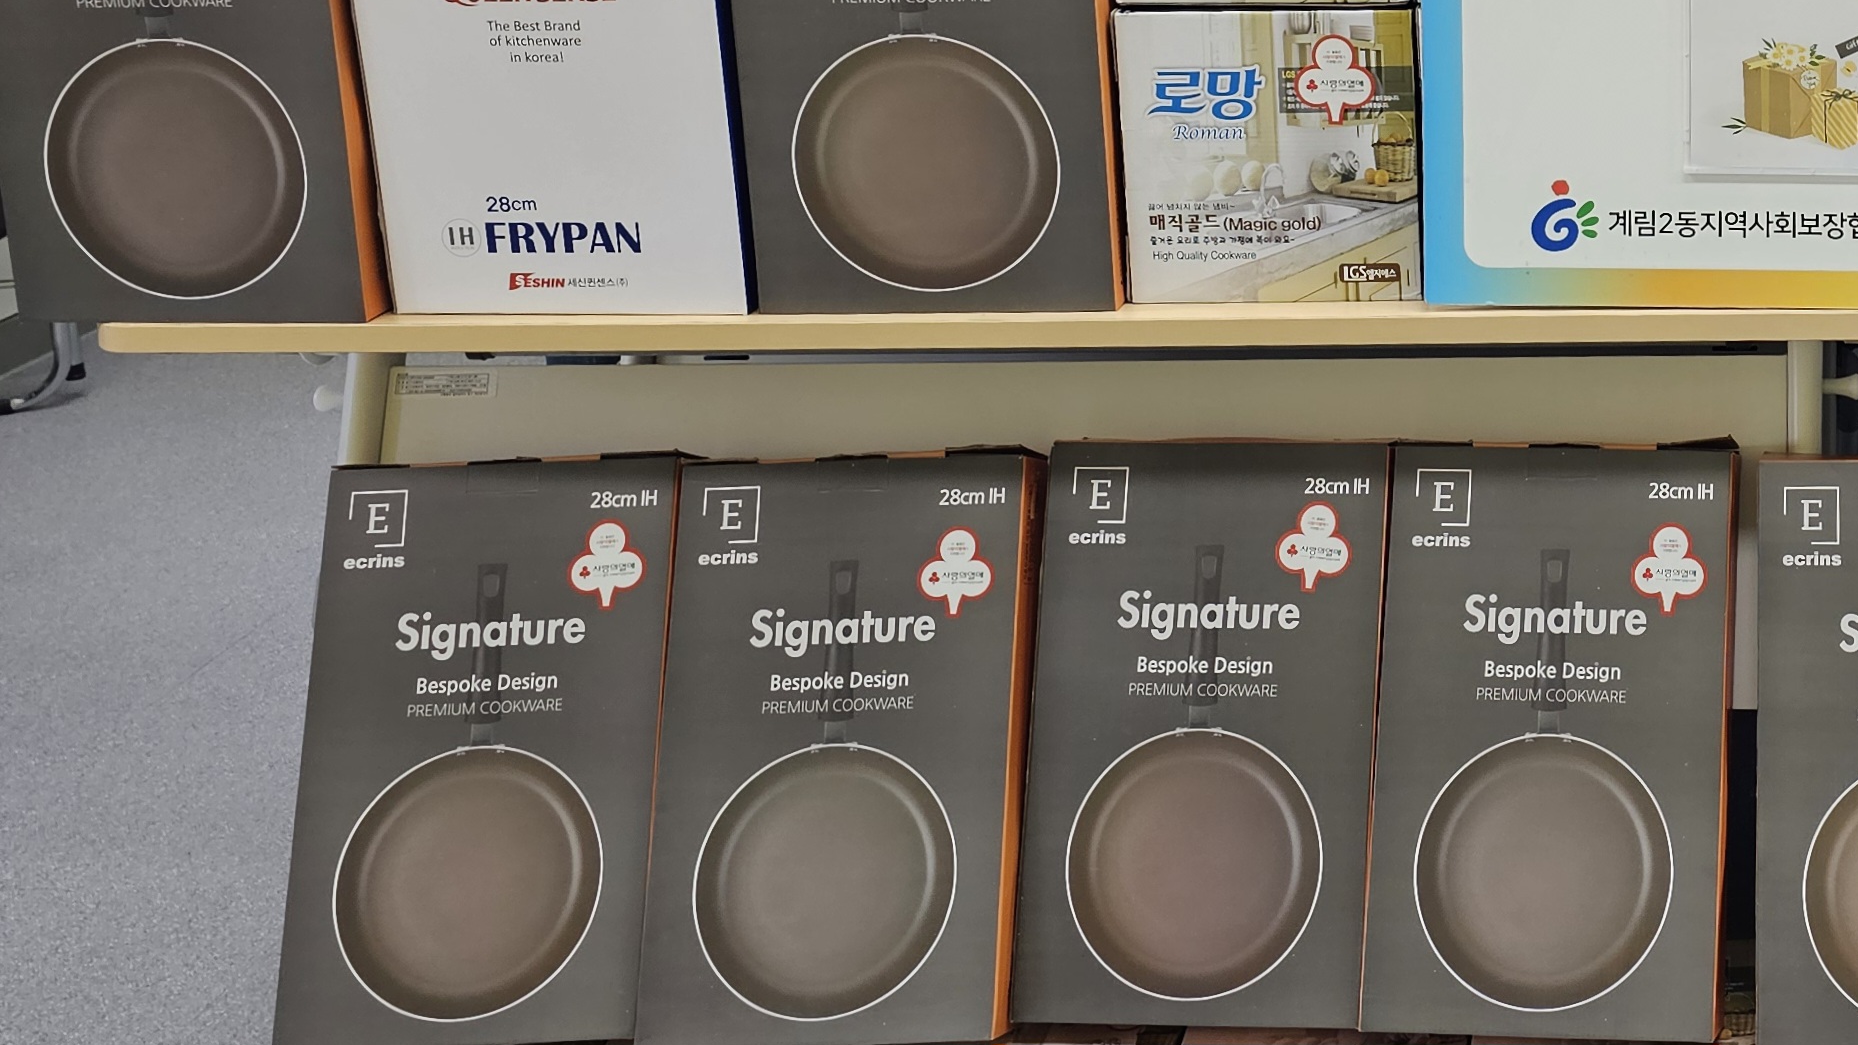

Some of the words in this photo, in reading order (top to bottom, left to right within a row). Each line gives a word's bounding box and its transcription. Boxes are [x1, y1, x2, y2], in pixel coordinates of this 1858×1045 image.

[487, 20, 510, 32] The
[513, 21, 540, 32] Best
[544, 20, 581, 32] Brand
[489, 35, 502, 47] of
[505, 35, 582, 47] kitchenware
[510, 52, 522, 63] in
[525, 52, 564, 63] korea!
[1147, 64, 1265, 123] 로망
[1173, 123, 1246, 143] Roman
[485, 196, 537, 213] 28cm
[1150, 214, 1221, 233] 매직골드
[1223, 217, 1277, 232] (Magic
[1282, 217, 1322, 232] gold)
[448, 226, 475, 245] IH
[484, 221, 642, 253] FRYPAN
[1068, 529, 1127, 545] ecrins
[1411, 532, 1471, 548] ecrins
[343, 553, 405, 570] ecrins
[697, 549, 759, 566] ecrins
[1782, 550, 1842, 567] ecrins
[1116, 589, 1300, 641] Signature
[1462, 593, 1647, 645] Signature
[395, 611, 586, 661] Signature
[749, 608, 936, 658] Signature
[1136, 655, 1209, 677] Bespoke
[1213, 655, 1274, 678] Design
[1483, 659, 1557, 681] Bespoke
[1562, 661, 1622, 683] Design
[416, 673, 492, 697] Bespoke
[497, 671, 558, 693] Design
[769, 670, 845, 694] Bespoke
[849, 669, 909, 691] Design
[406, 701, 476, 718] PREMIUM
[479, 697, 563, 715] COOKWARE
